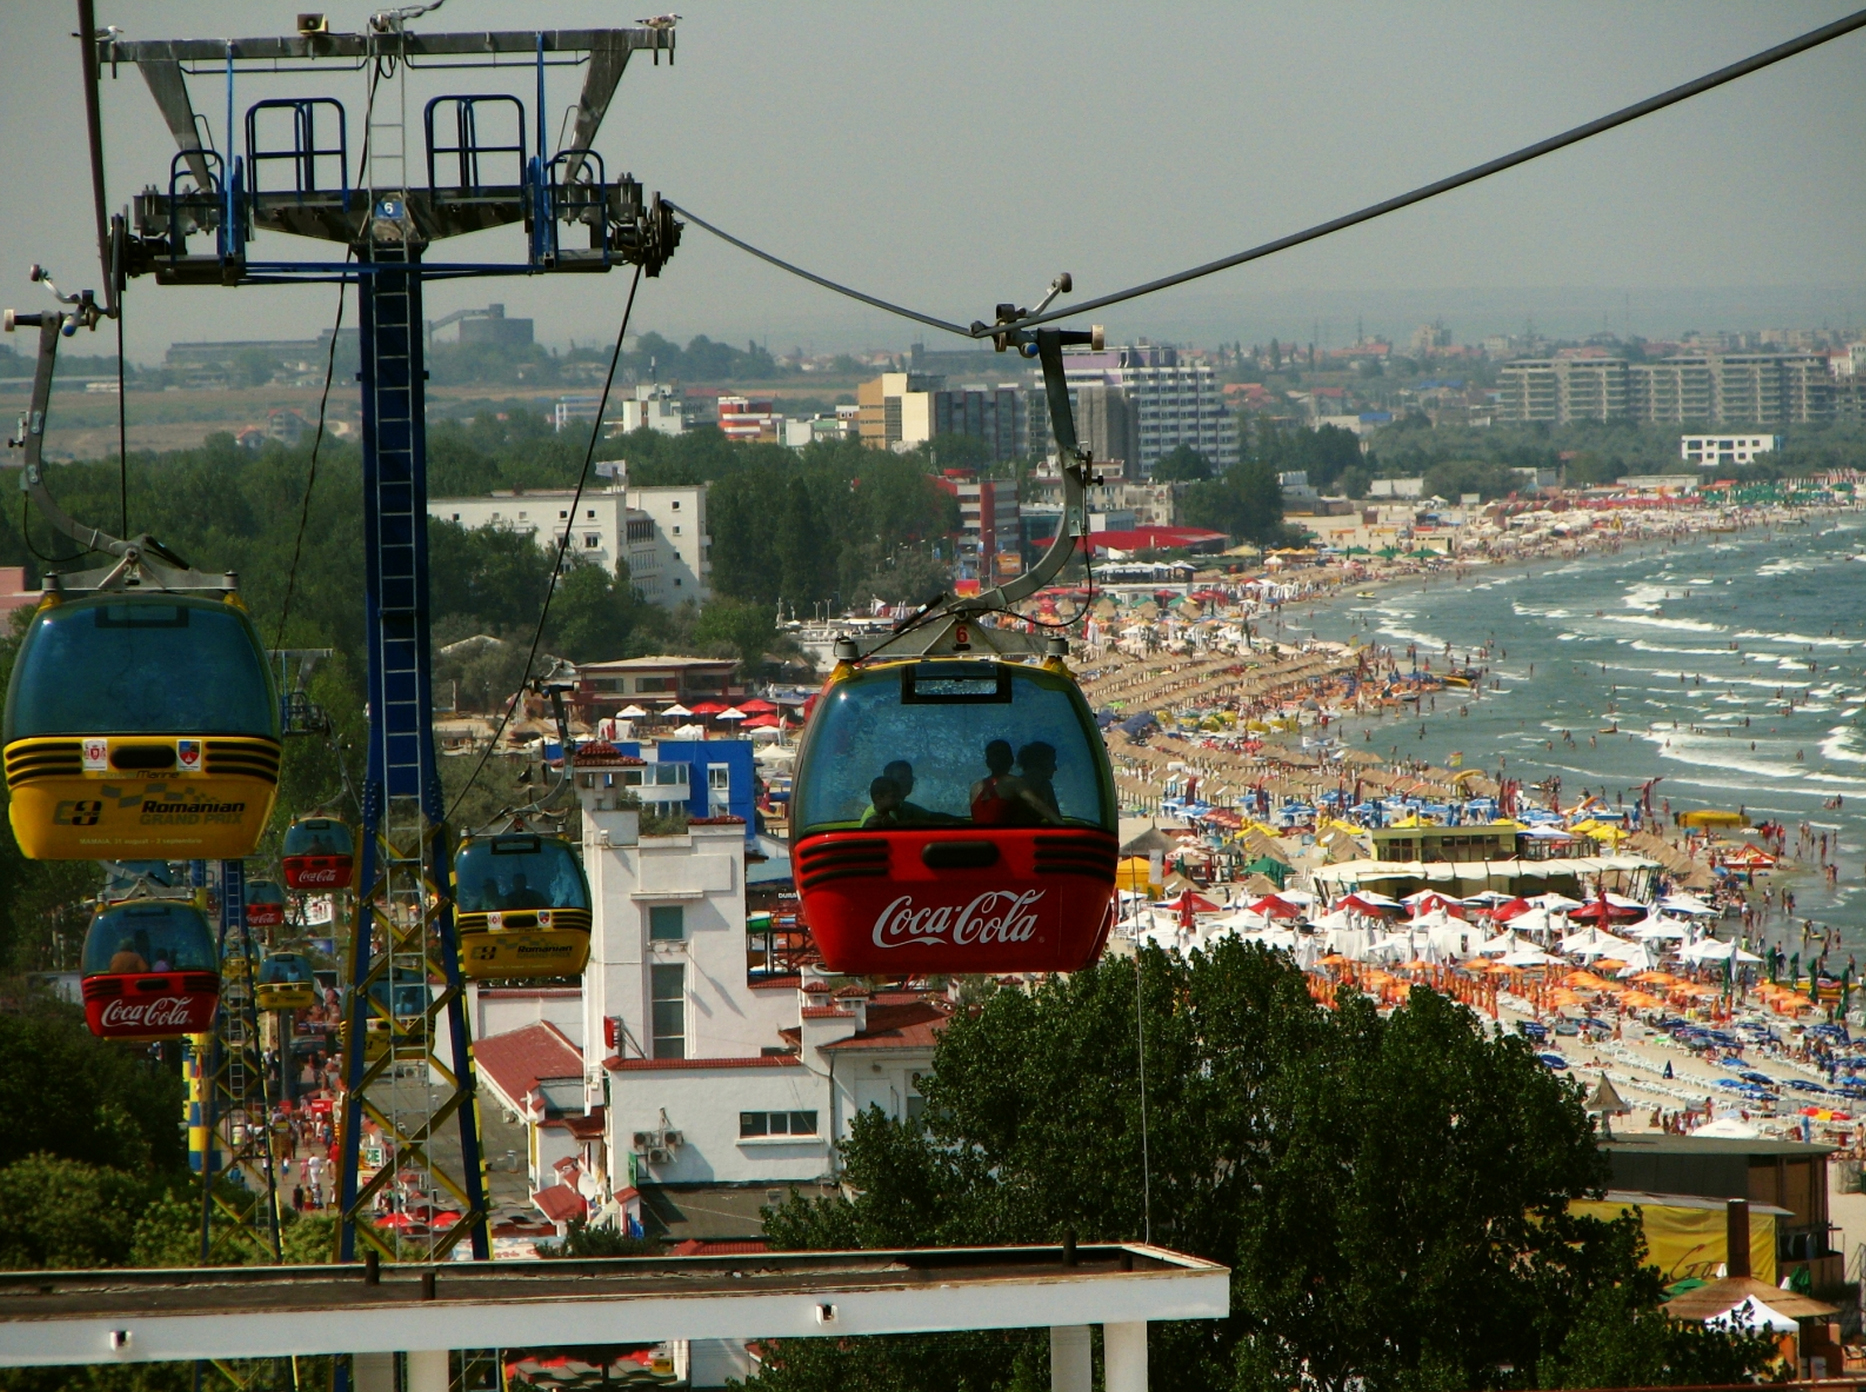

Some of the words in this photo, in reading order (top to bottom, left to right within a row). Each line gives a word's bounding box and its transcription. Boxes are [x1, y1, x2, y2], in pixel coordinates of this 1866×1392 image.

[384, 202, 394, 215] 6
[956, 625, 968, 643] 6
[141, 800, 246, 813] Romanian
[139, 813, 199, 825] GRAND
[203, 812, 243, 825] PRIX
[517, 945, 573, 953] Romanian
